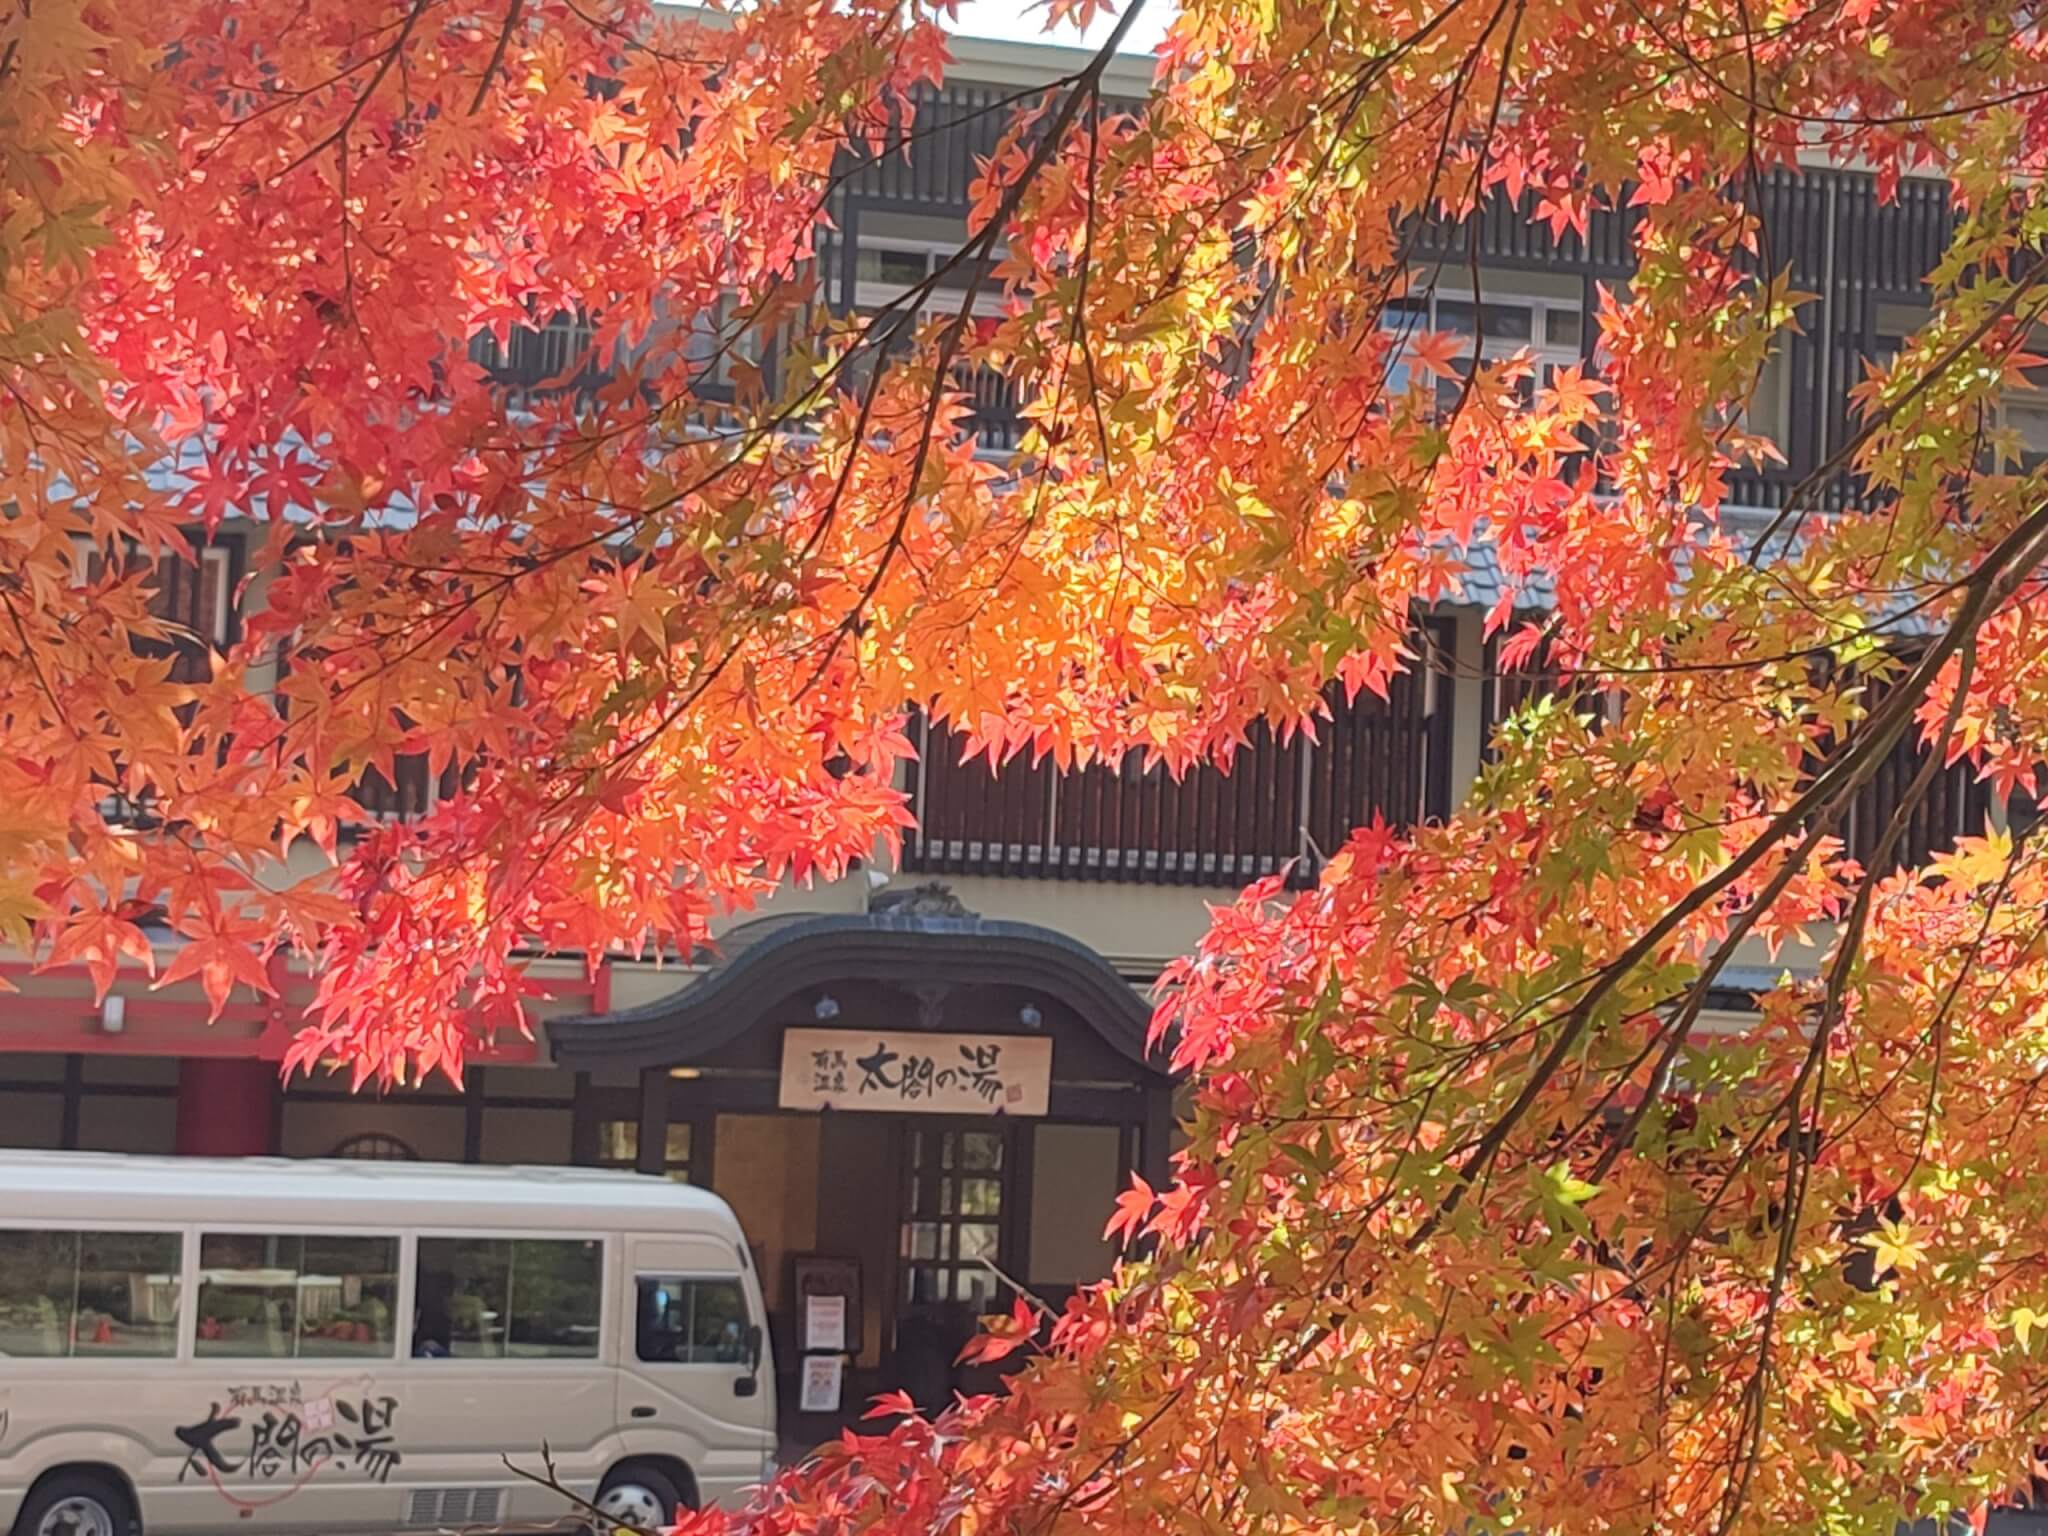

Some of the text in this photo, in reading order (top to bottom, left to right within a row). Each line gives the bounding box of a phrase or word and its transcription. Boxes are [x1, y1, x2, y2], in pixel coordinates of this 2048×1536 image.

[856, 1042, 1004, 1102] 太閤の湯
[174, 1397, 402, 1484] 太閤の湯
